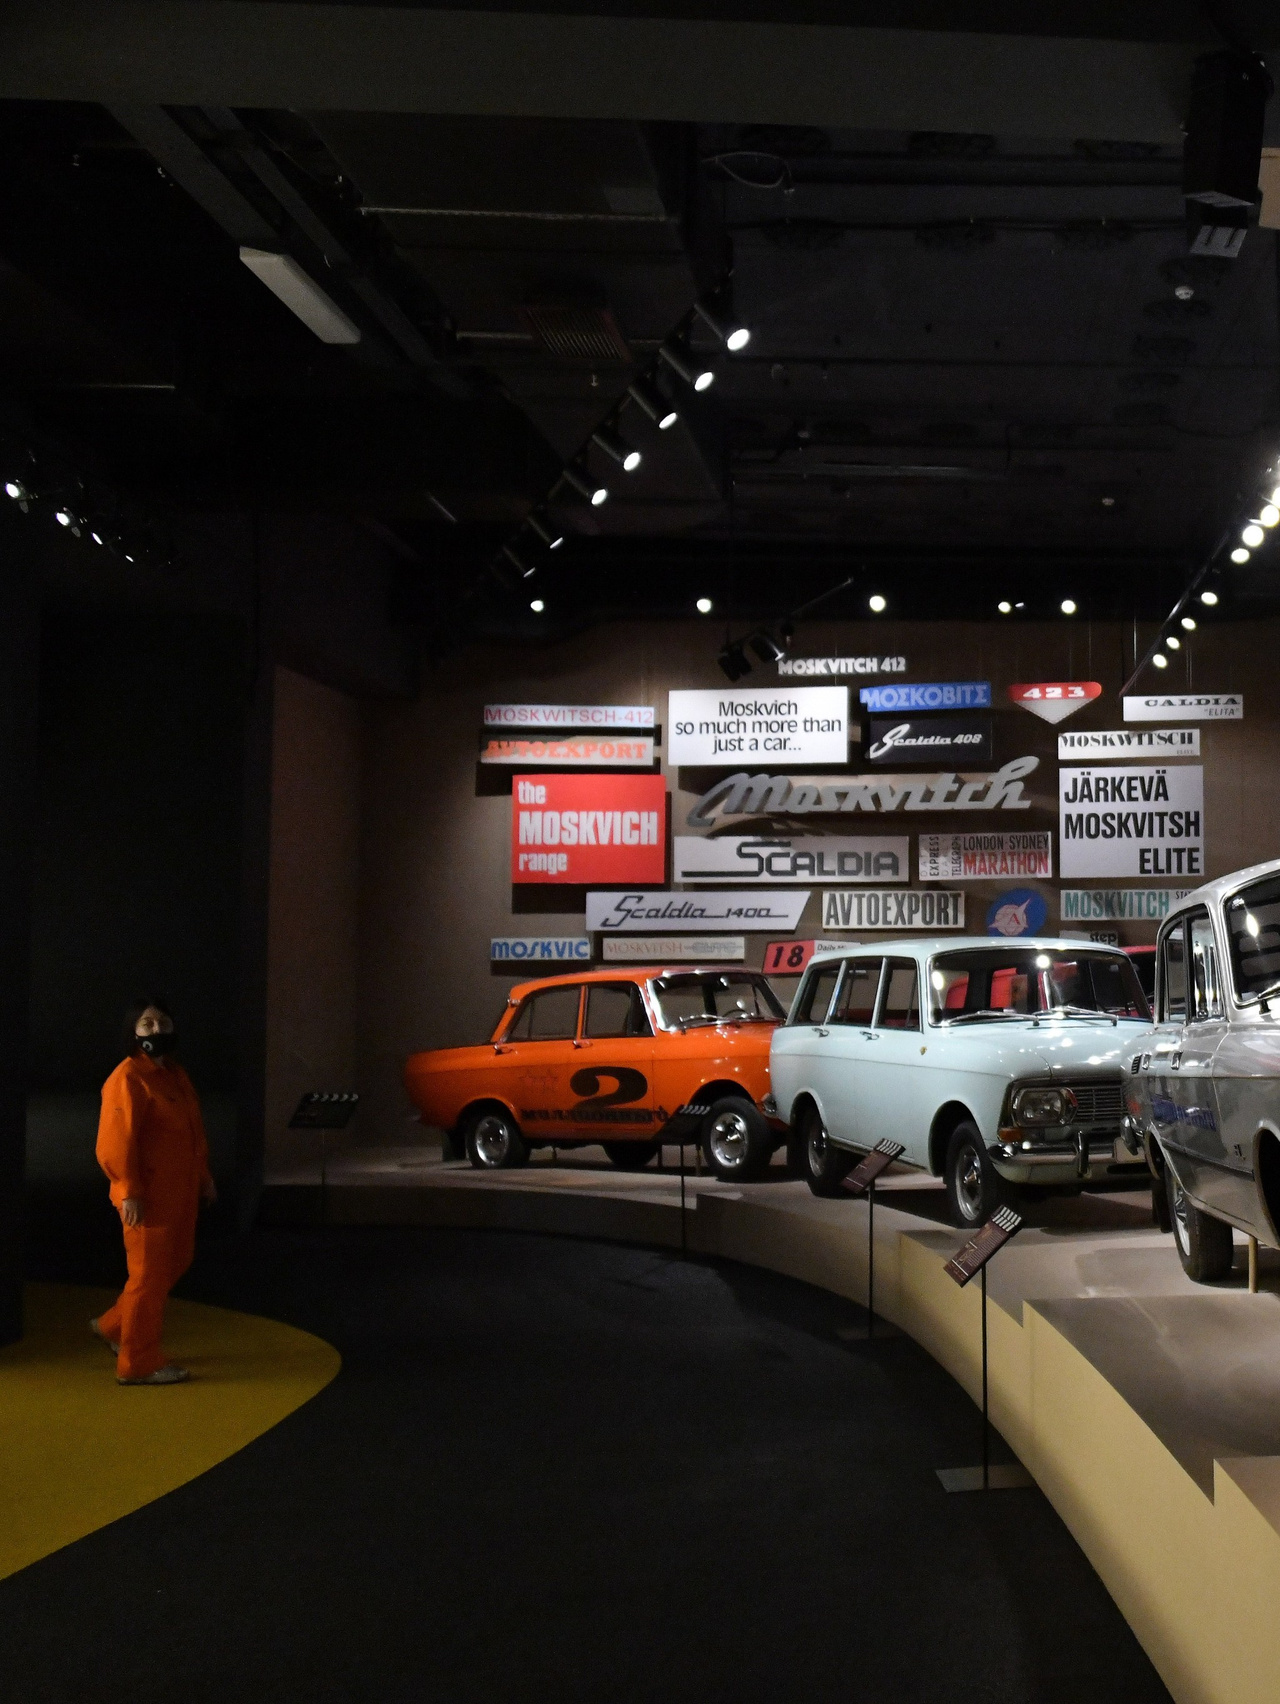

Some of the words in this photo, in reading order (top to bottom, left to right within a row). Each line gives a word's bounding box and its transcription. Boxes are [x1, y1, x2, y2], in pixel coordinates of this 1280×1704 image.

[778, 657, 878, 675] MOSKVITCH
[880, 657, 906, 672] 412
[1022, 686, 1086, 699] 423
[484, 707, 654, 724] MOSKWITSCH-412
[718, 700, 798, 717] Moskvich
[675, 721, 695, 735] so
[699, 719, 747, 734] much
[752, 719, 798, 733] more
[803, 717, 842, 732] than
[712, 736, 744, 755] just
[749, 738, 759, 751] a
[763, 737, 802, 751] car...
[869, 723, 951, 759] Scaldia
[953, 733, 983, 745] 408
[1060, 731, 1194, 748] MOSKWITSCH
[518, 780, 547, 804] the
[1064, 769, 1169, 803] JÄRKEVÄ
[518, 811, 659, 845] MOSKVICH
[1064, 810, 1200, 840] MOSKVITSH
[518, 852, 568, 876] range
[929, 836, 940, 877] EXPRESS
[963, 851, 1049, 876] MARATHON
[1139, 847, 1200, 875] ELITE
[725, 907, 780, 919] 1400
[824, 892, 962, 926] AVTOEXPORT
[1064, 891, 1170, 918] MOSKVITCH
[491, 940, 589, 959] MOSKVIC
[771, 945, 805, 968] 18
[570, 1066, 650, 1122] 2
